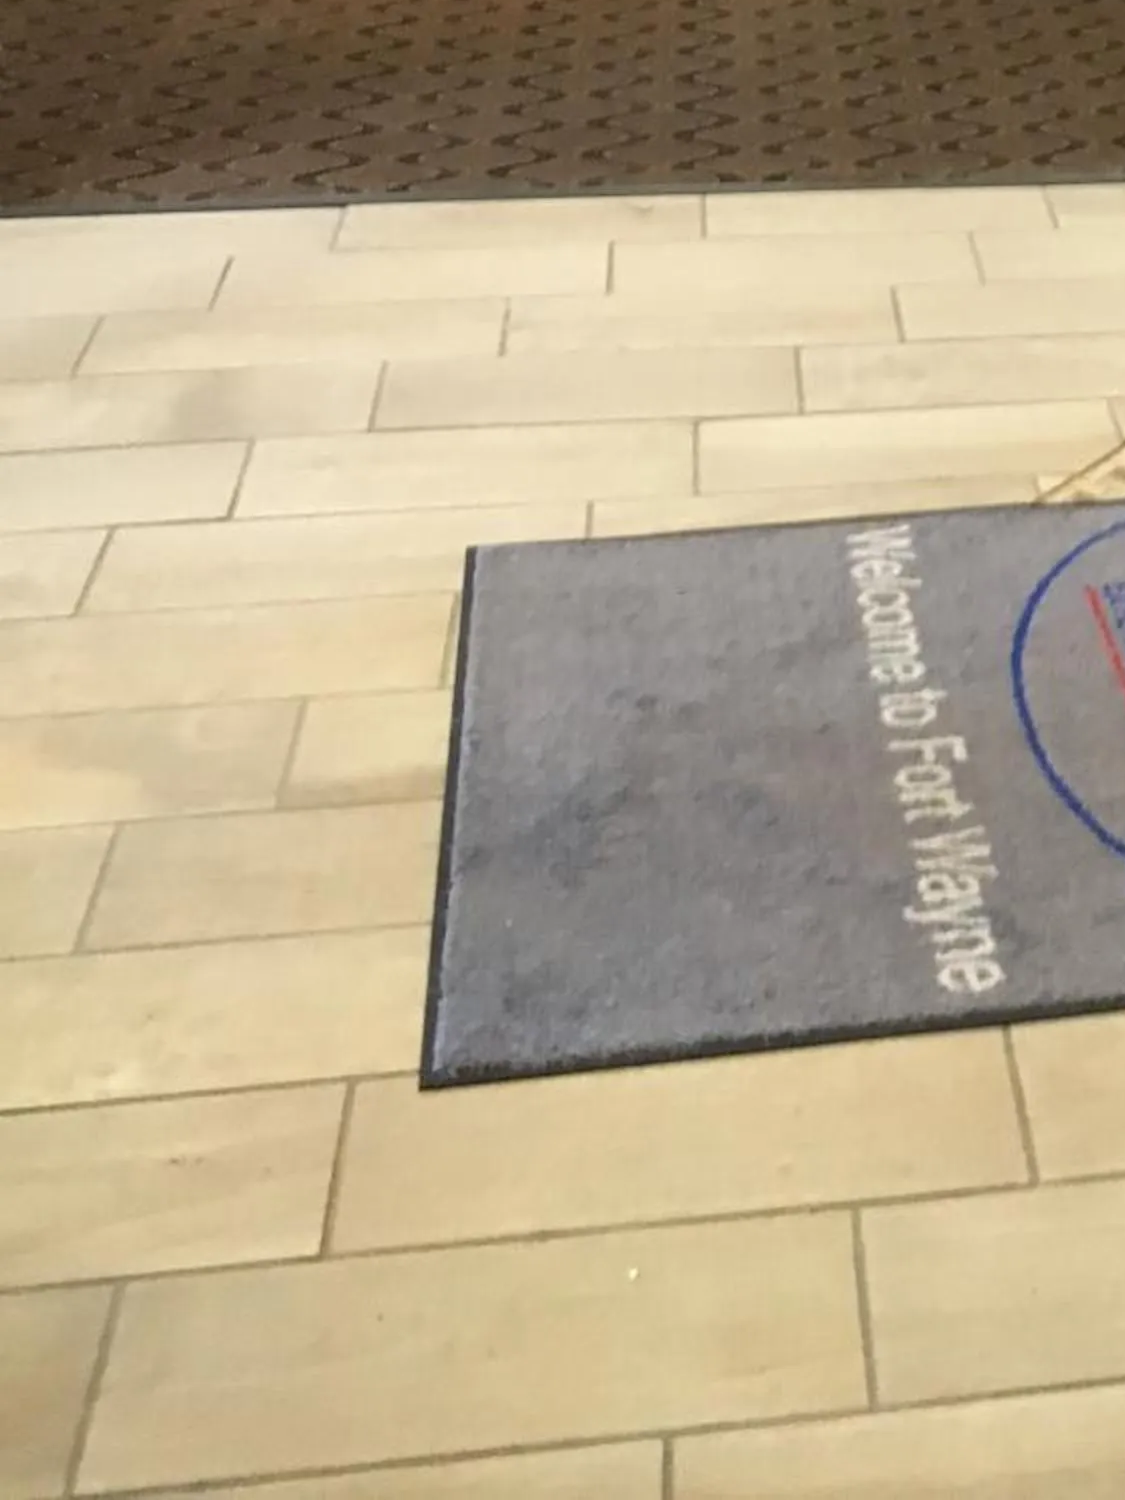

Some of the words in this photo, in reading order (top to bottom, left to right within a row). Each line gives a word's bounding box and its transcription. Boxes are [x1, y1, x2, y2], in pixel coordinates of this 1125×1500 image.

[846, 523, 927, 684] Welcome
[880, 687, 948, 727] to
[884, 734, 976, 821] Fort
[903, 826, 1007, 994] Wayne
